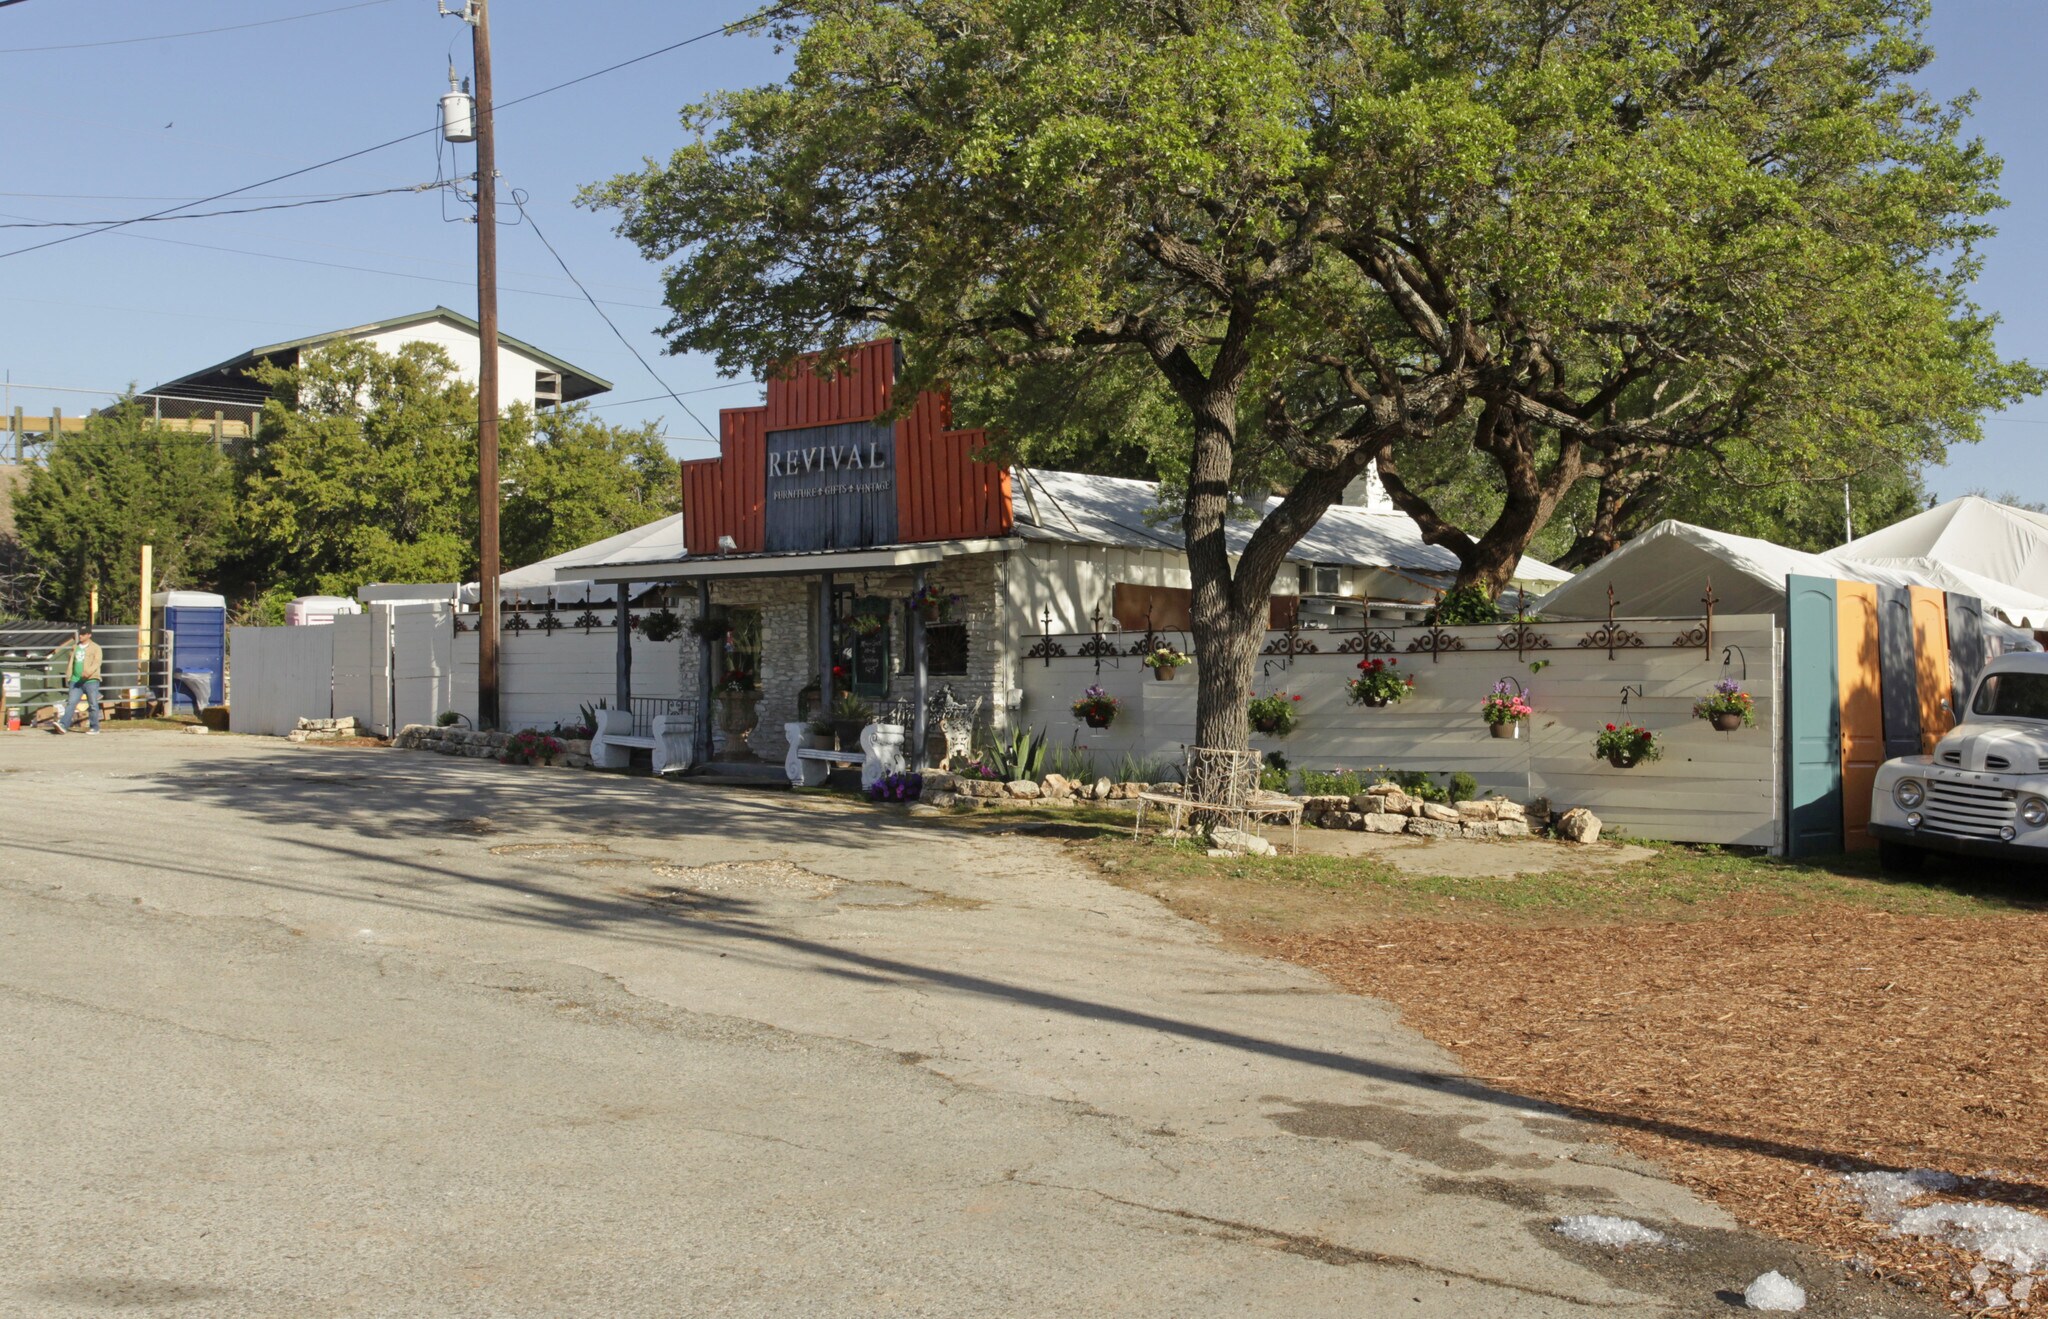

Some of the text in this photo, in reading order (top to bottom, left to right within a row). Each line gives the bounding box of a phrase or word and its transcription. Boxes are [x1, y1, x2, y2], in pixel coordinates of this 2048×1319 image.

[768, 442, 885, 477] REVIVAL
[773, 480, 890, 500] FURNITURE GIFTS VINTAGE
